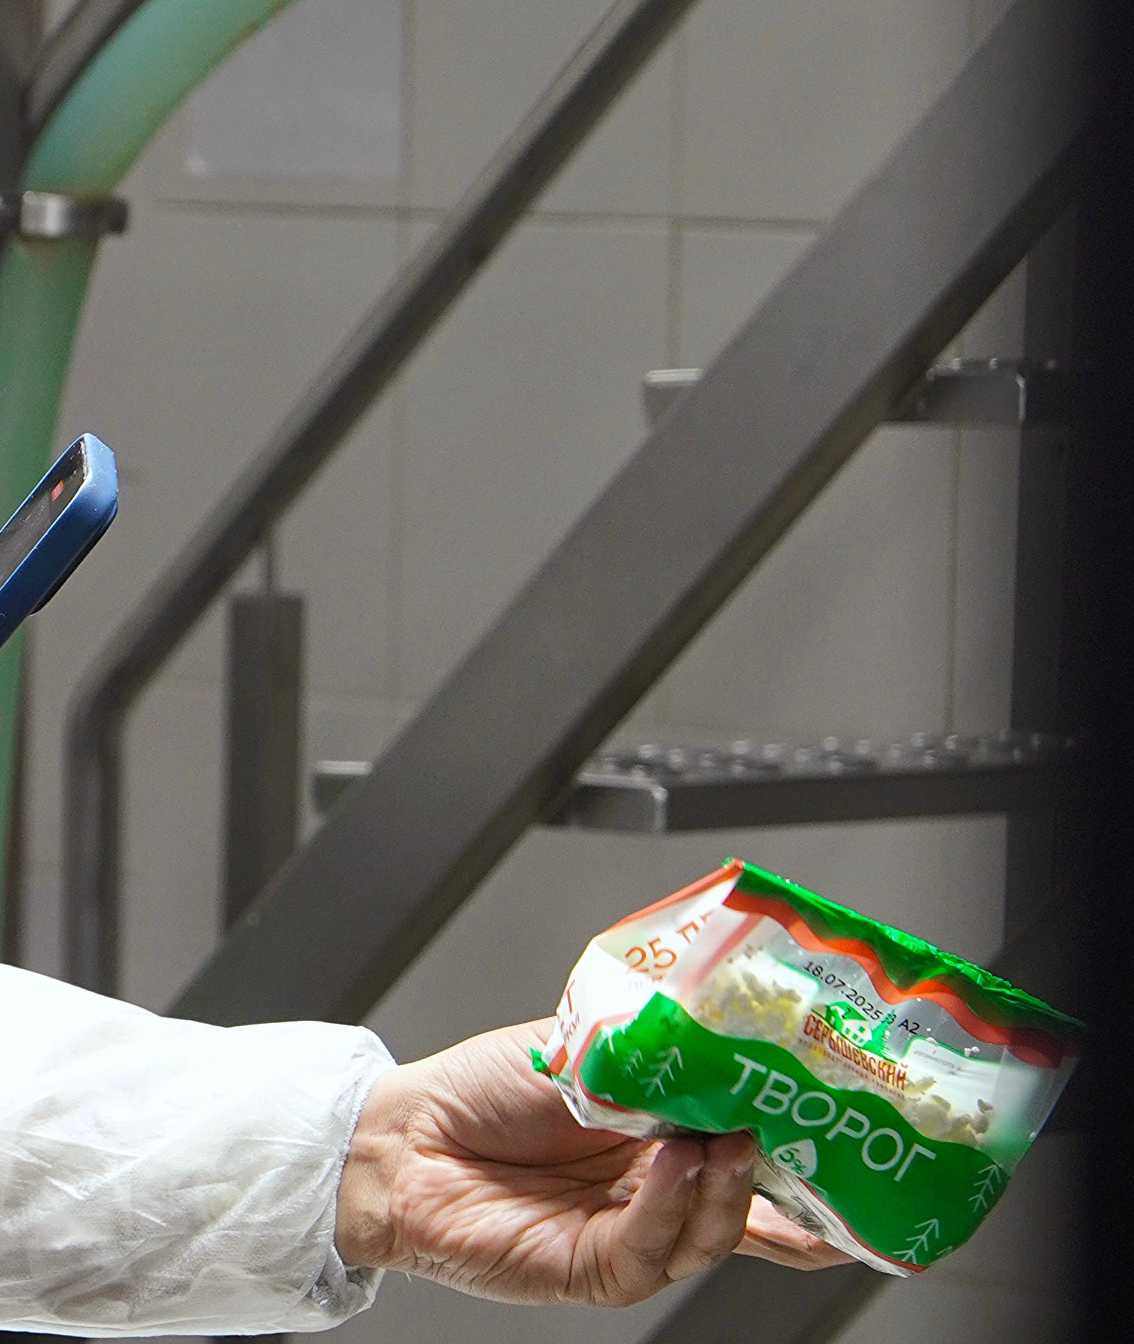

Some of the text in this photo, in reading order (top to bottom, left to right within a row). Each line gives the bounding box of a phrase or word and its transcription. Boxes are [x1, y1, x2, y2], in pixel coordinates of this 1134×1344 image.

[625, 937, 677, 974] 25
[803, 960, 884, 1021] 18.07.2025
[803, 1013, 909, 1091] СЕРЫШЕВСКИЙ
[729, 1052, 937, 1183] ТВОРОГ
